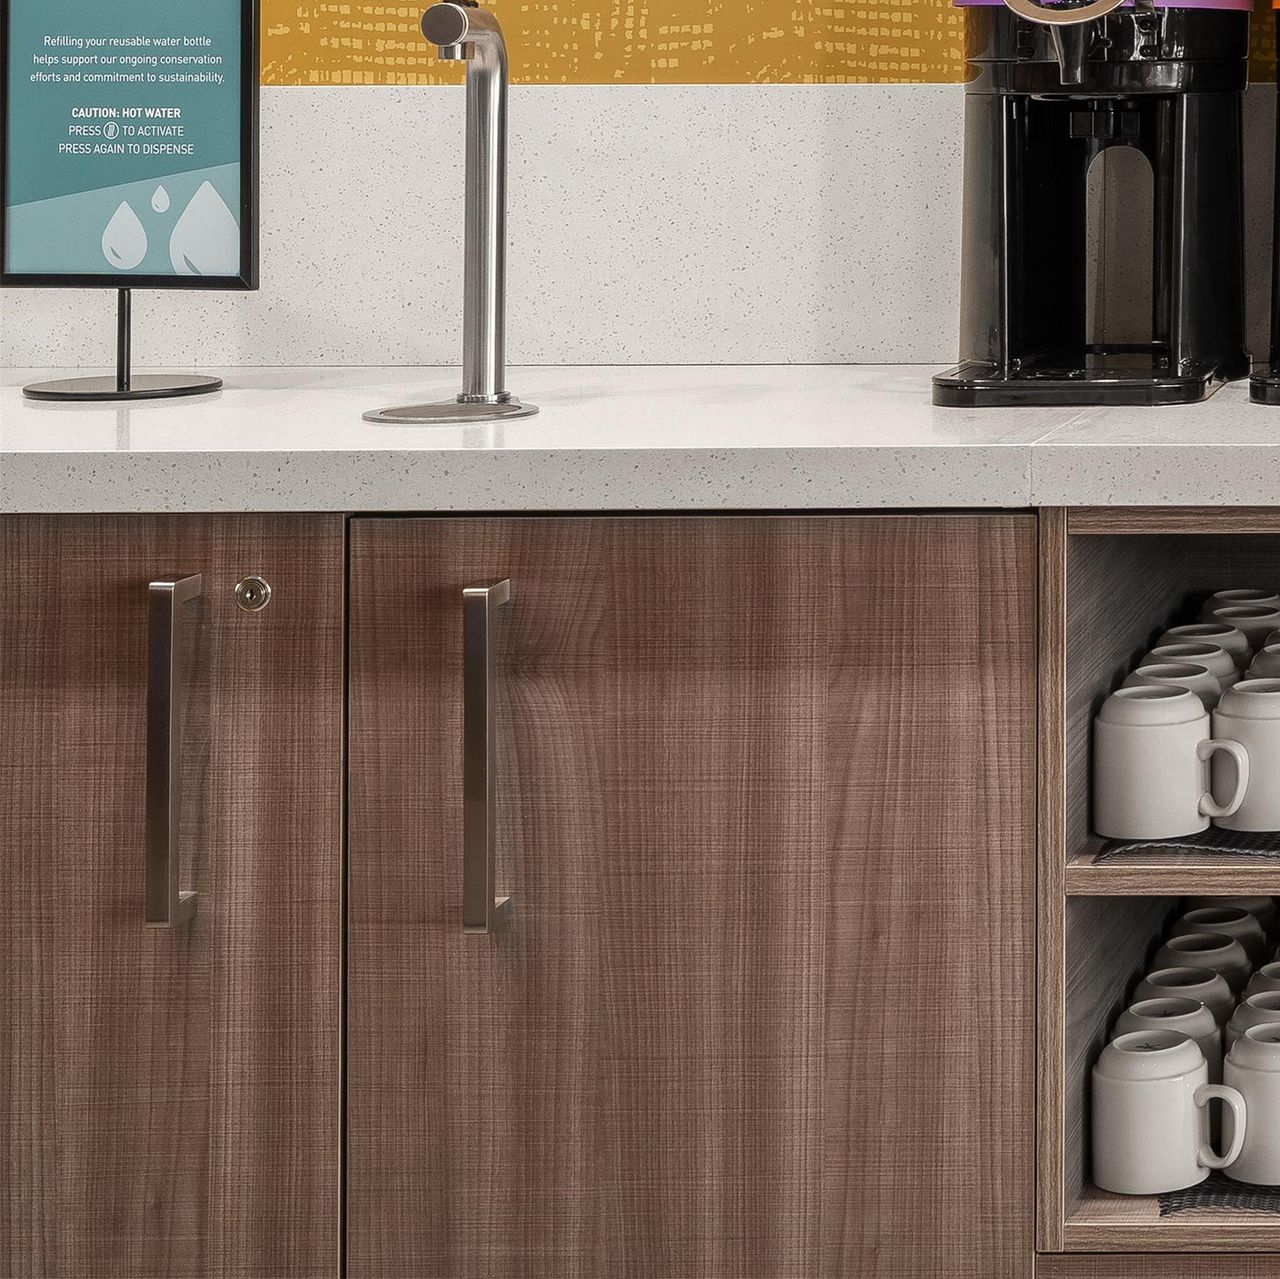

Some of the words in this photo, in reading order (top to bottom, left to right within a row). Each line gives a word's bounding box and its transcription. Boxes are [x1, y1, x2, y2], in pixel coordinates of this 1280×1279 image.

[43, 35, 84, 48] Refilling
[85, 37, 108, 48] your
[109, 35, 151, 47] reusable
[153, 37, 181, 47] water
[183, 35, 212, 47] bottle
[33, 53, 60, 65] helps
[61, 54, 99, 66] support
[101, 56, 117, 65] our
[119, 54, 158, 66] ongoing
[159, 54, 222, 65] conservation
[30, 71, 61, 82] efforts
[63, 72, 81, 82] and
[83, 72, 145, 82] commitment
[146, 73, 157, 82] to
[158, 72, 225, 84] sustainability.
[71, 107, 120, 118] CAUTION:
[122, 107, 143, 118] HOT
[145, 107, 181, 118] WATER
[68, 125, 101, 136] PRESS
[122, 125, 136, 137] TO
[137, 125, 185, 137] ACTIVATE
[59, 143, 92, 154] PRESS
[93, 143, 125, 154] AGAIN
[127, 143, 141, 154] TO
[142, 143, 194, 155] DISPENSE
